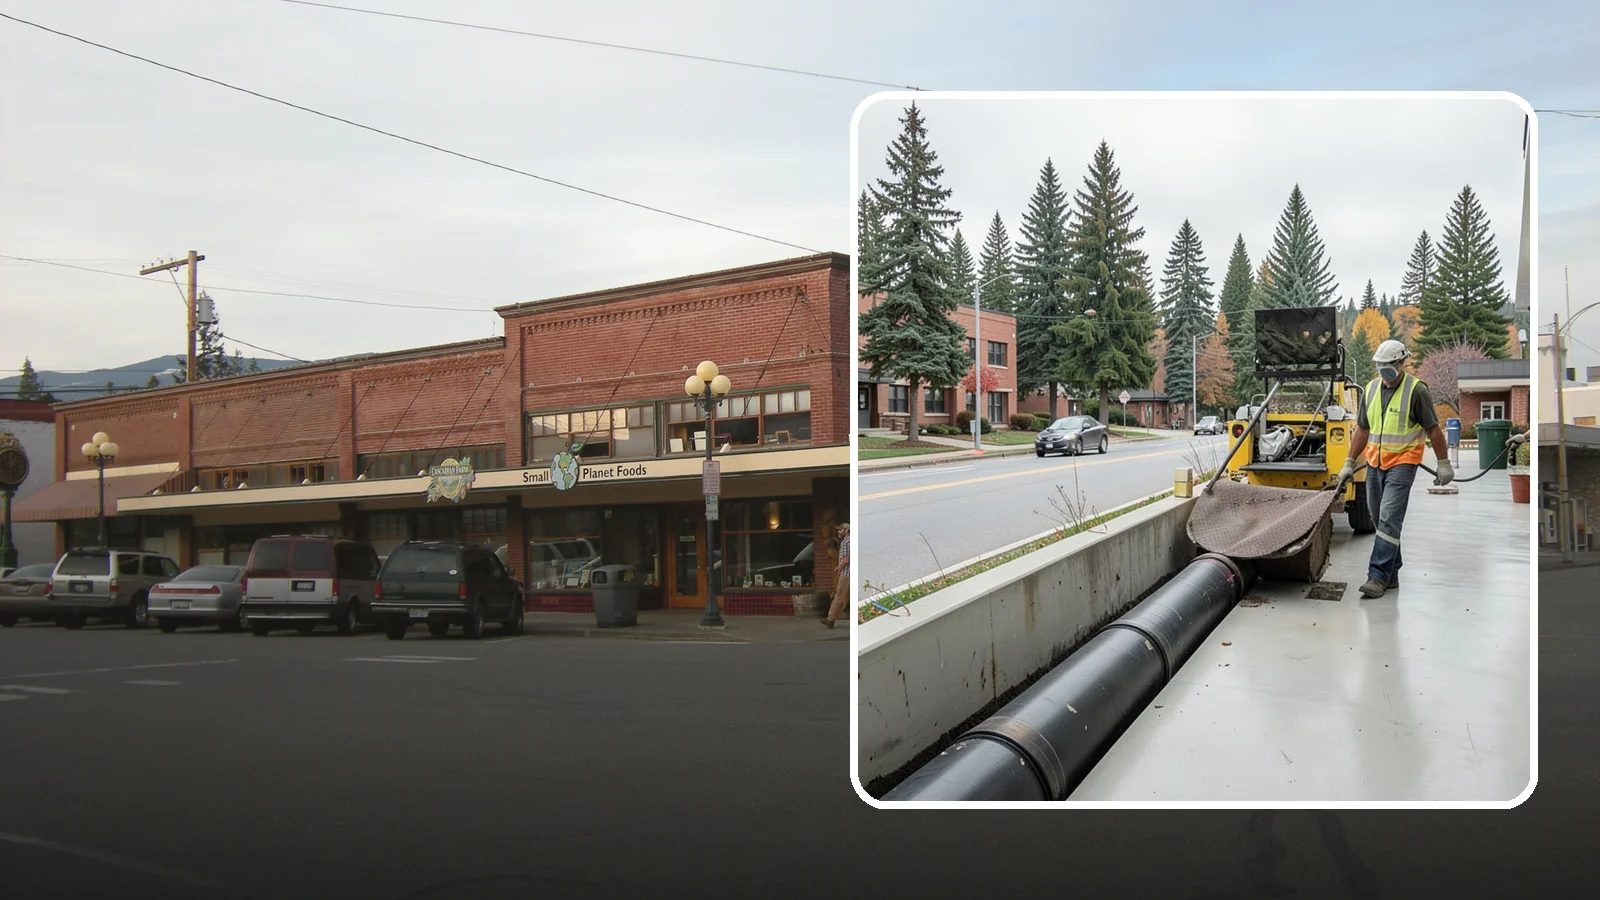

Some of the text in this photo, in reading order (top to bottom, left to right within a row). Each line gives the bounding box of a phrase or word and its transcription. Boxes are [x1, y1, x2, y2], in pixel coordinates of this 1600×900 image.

[523, 464, 647, 482] Small Planet Foods
